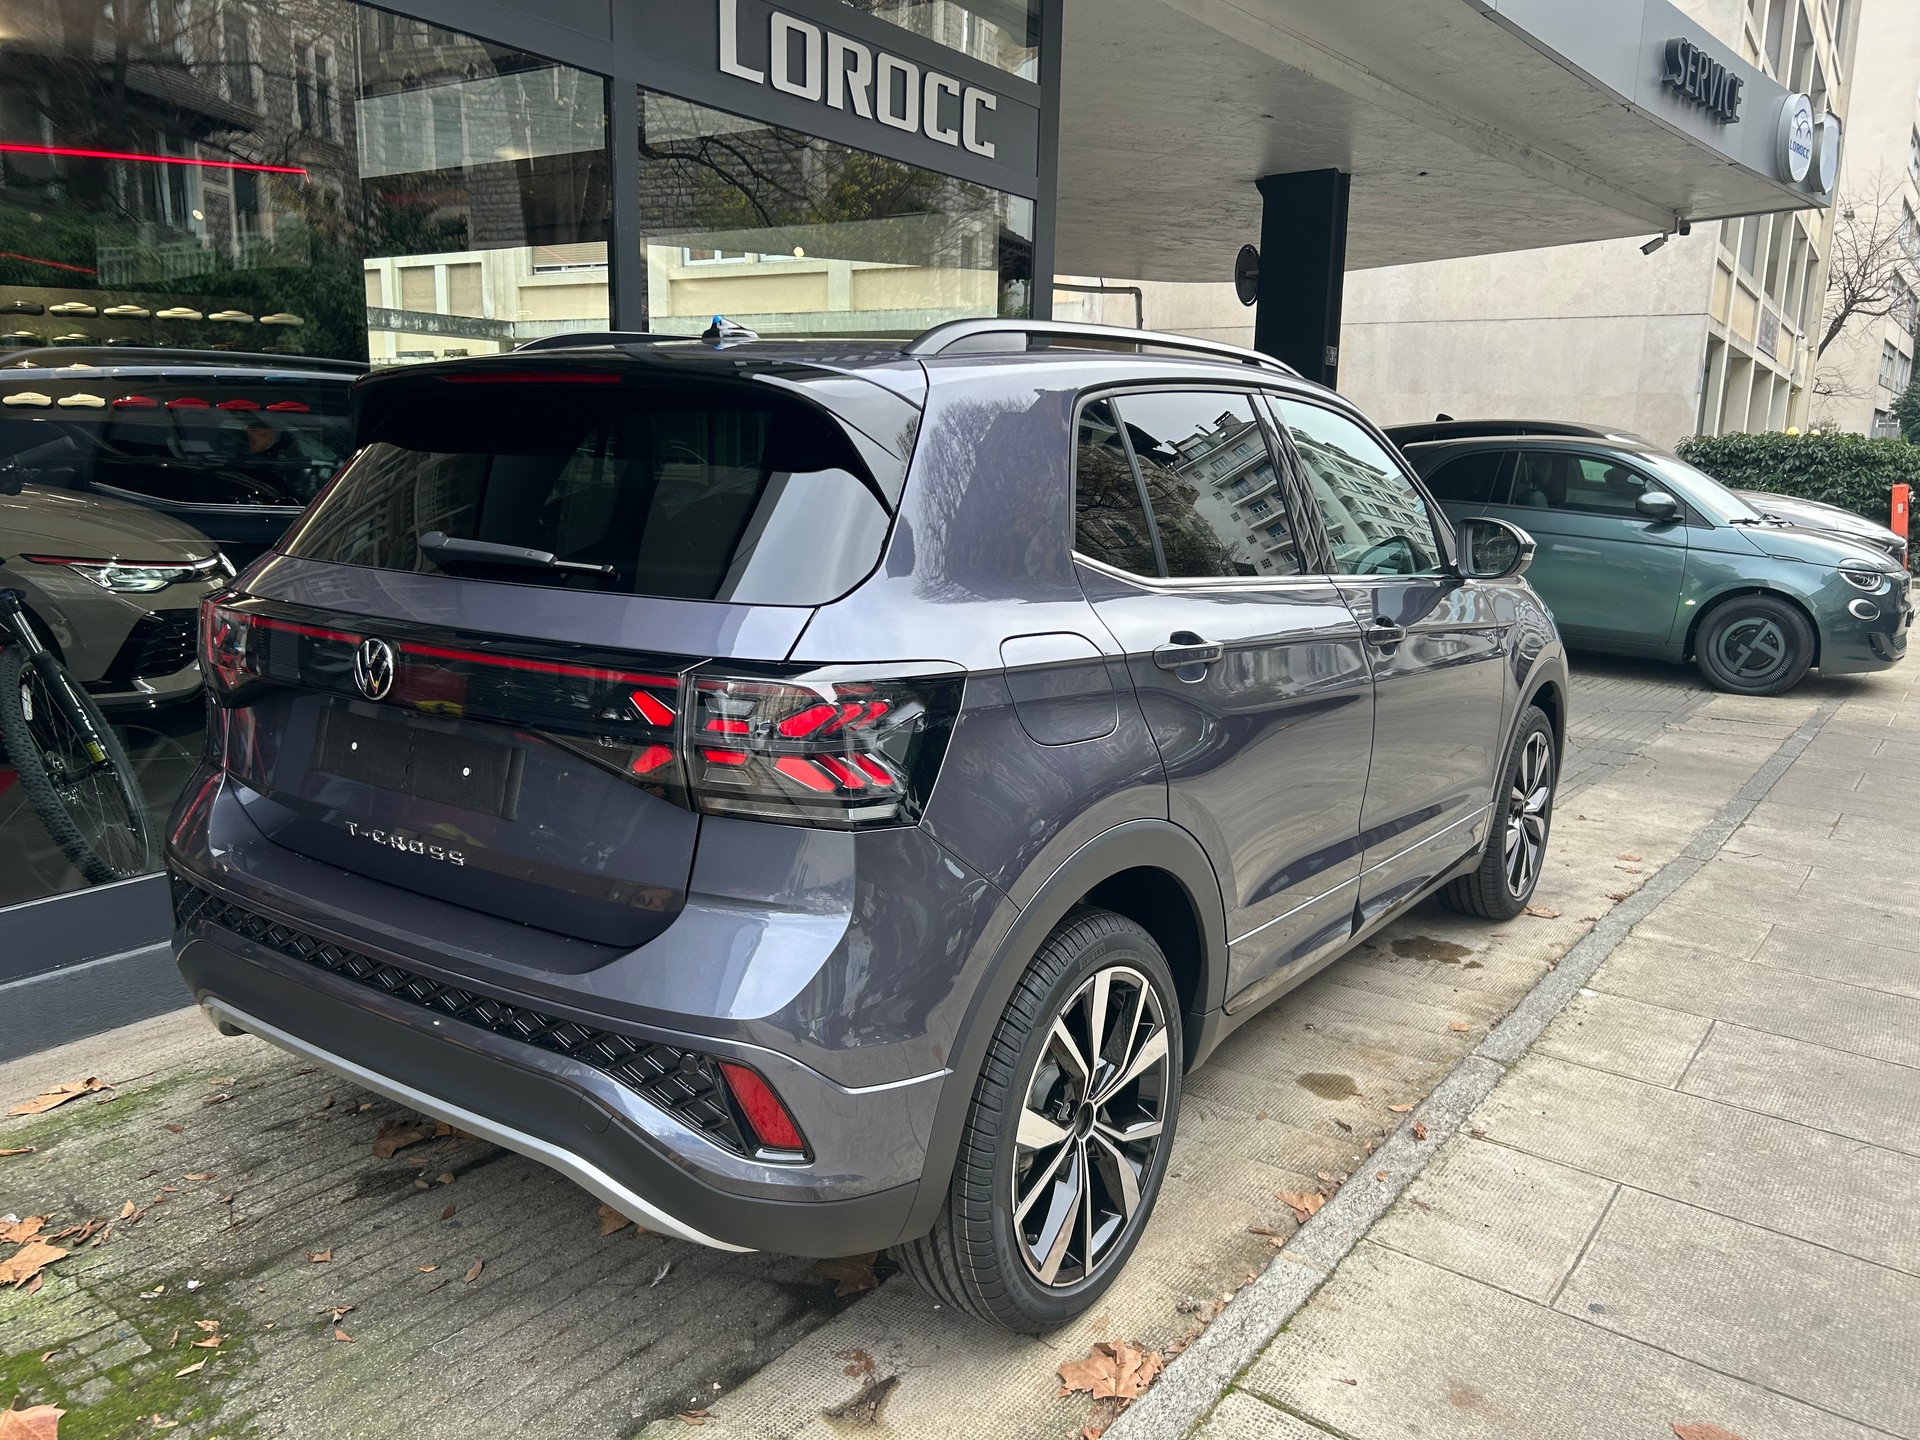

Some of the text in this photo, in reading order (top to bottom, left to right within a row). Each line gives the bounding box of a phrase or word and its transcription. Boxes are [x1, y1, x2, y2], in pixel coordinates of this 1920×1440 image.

[719, 0, 997, 159] LOROCC
[1668, 36, 1744, 124] SERVICE
[1789, 138, 1811, 160] LOROCC
[345, 820, 465, 866] T-CROSS
